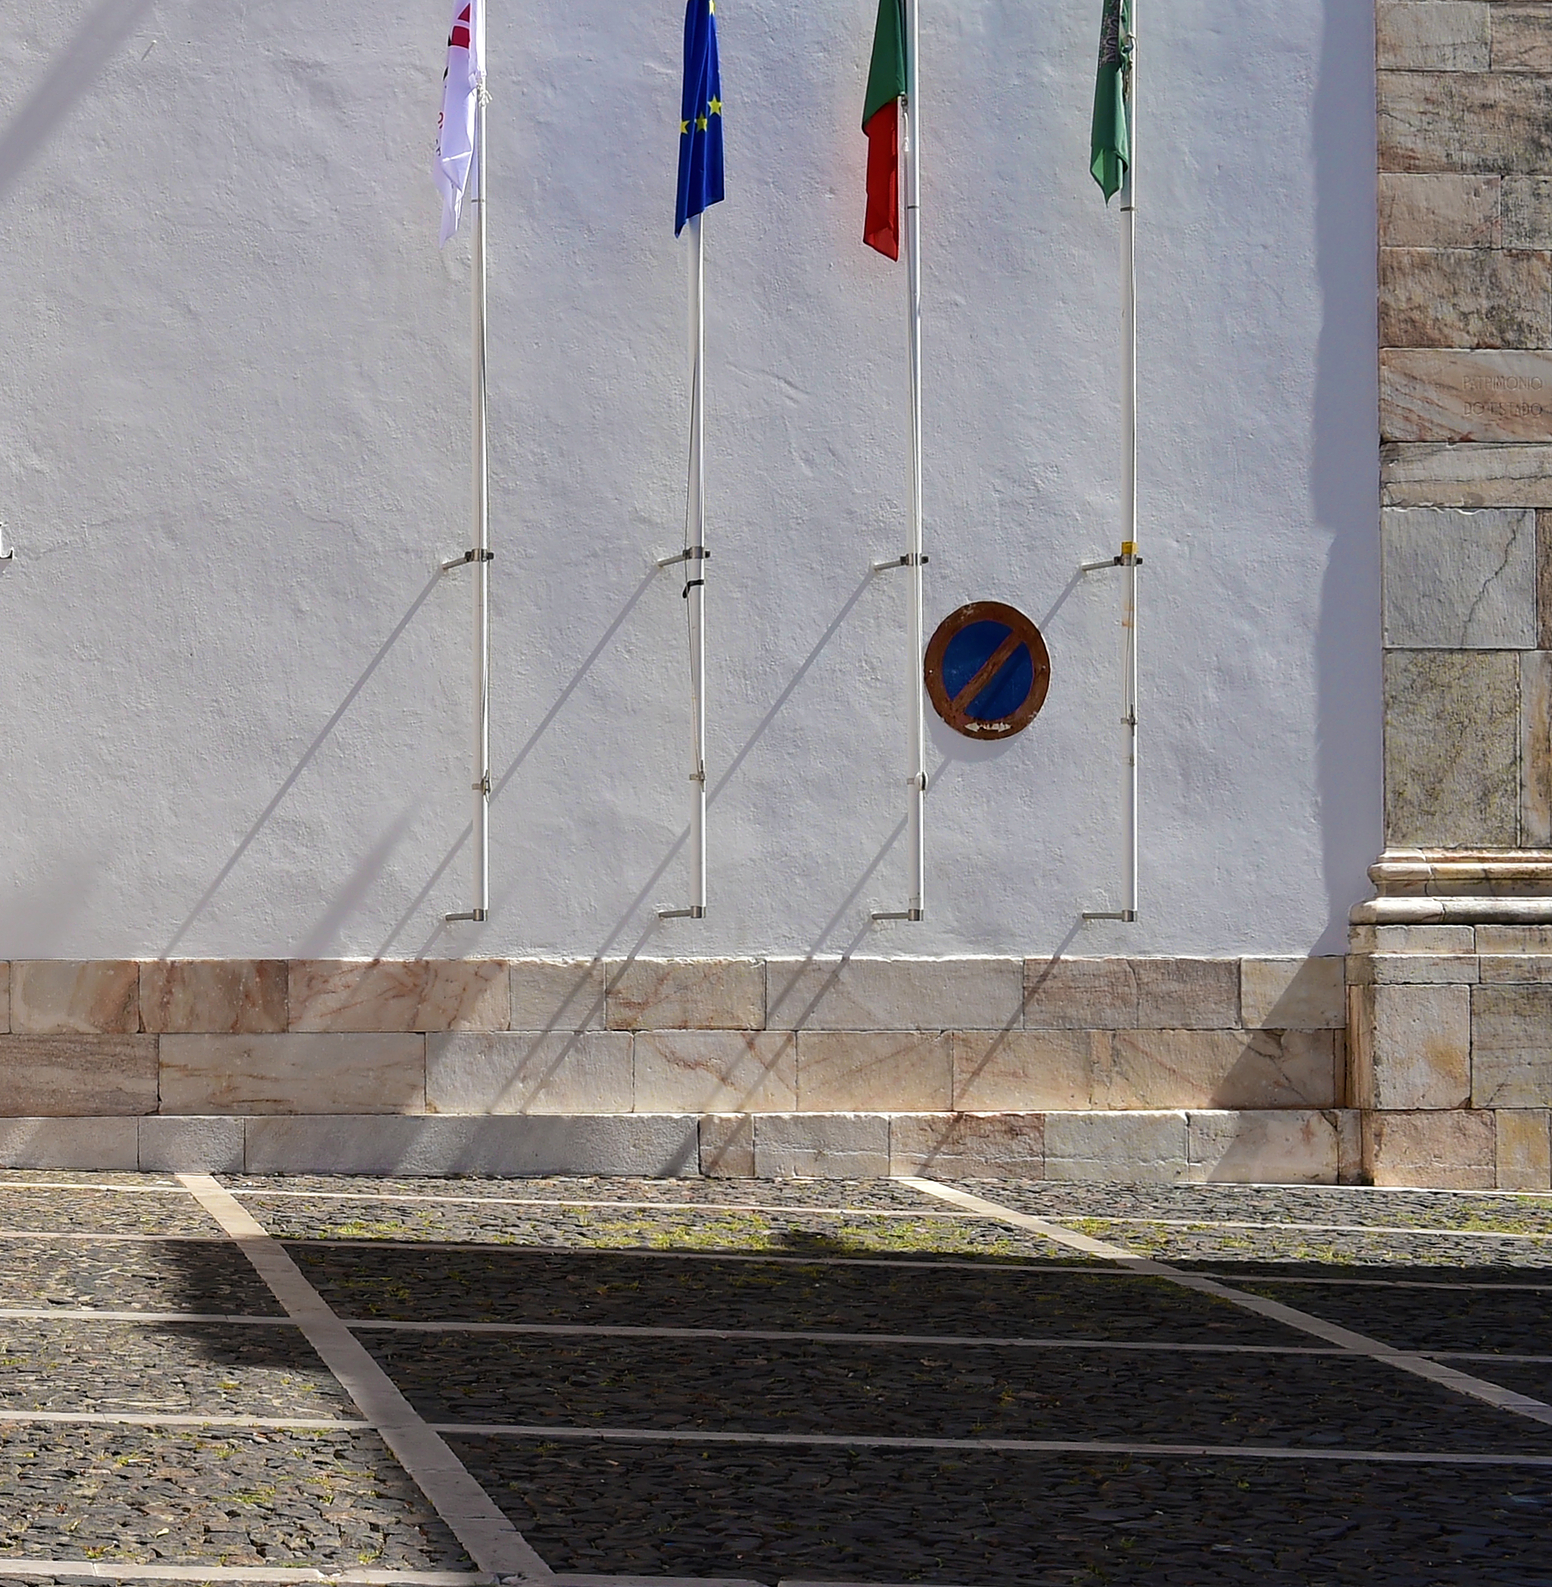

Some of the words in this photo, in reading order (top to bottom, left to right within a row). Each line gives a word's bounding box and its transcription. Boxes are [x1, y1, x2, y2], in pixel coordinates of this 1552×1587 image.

[1462, 375, 1543, 390] PATRIMONIO
[1463, 401, 1485, 416] DO
[1489, 402, 1543, 417] ESTADO
